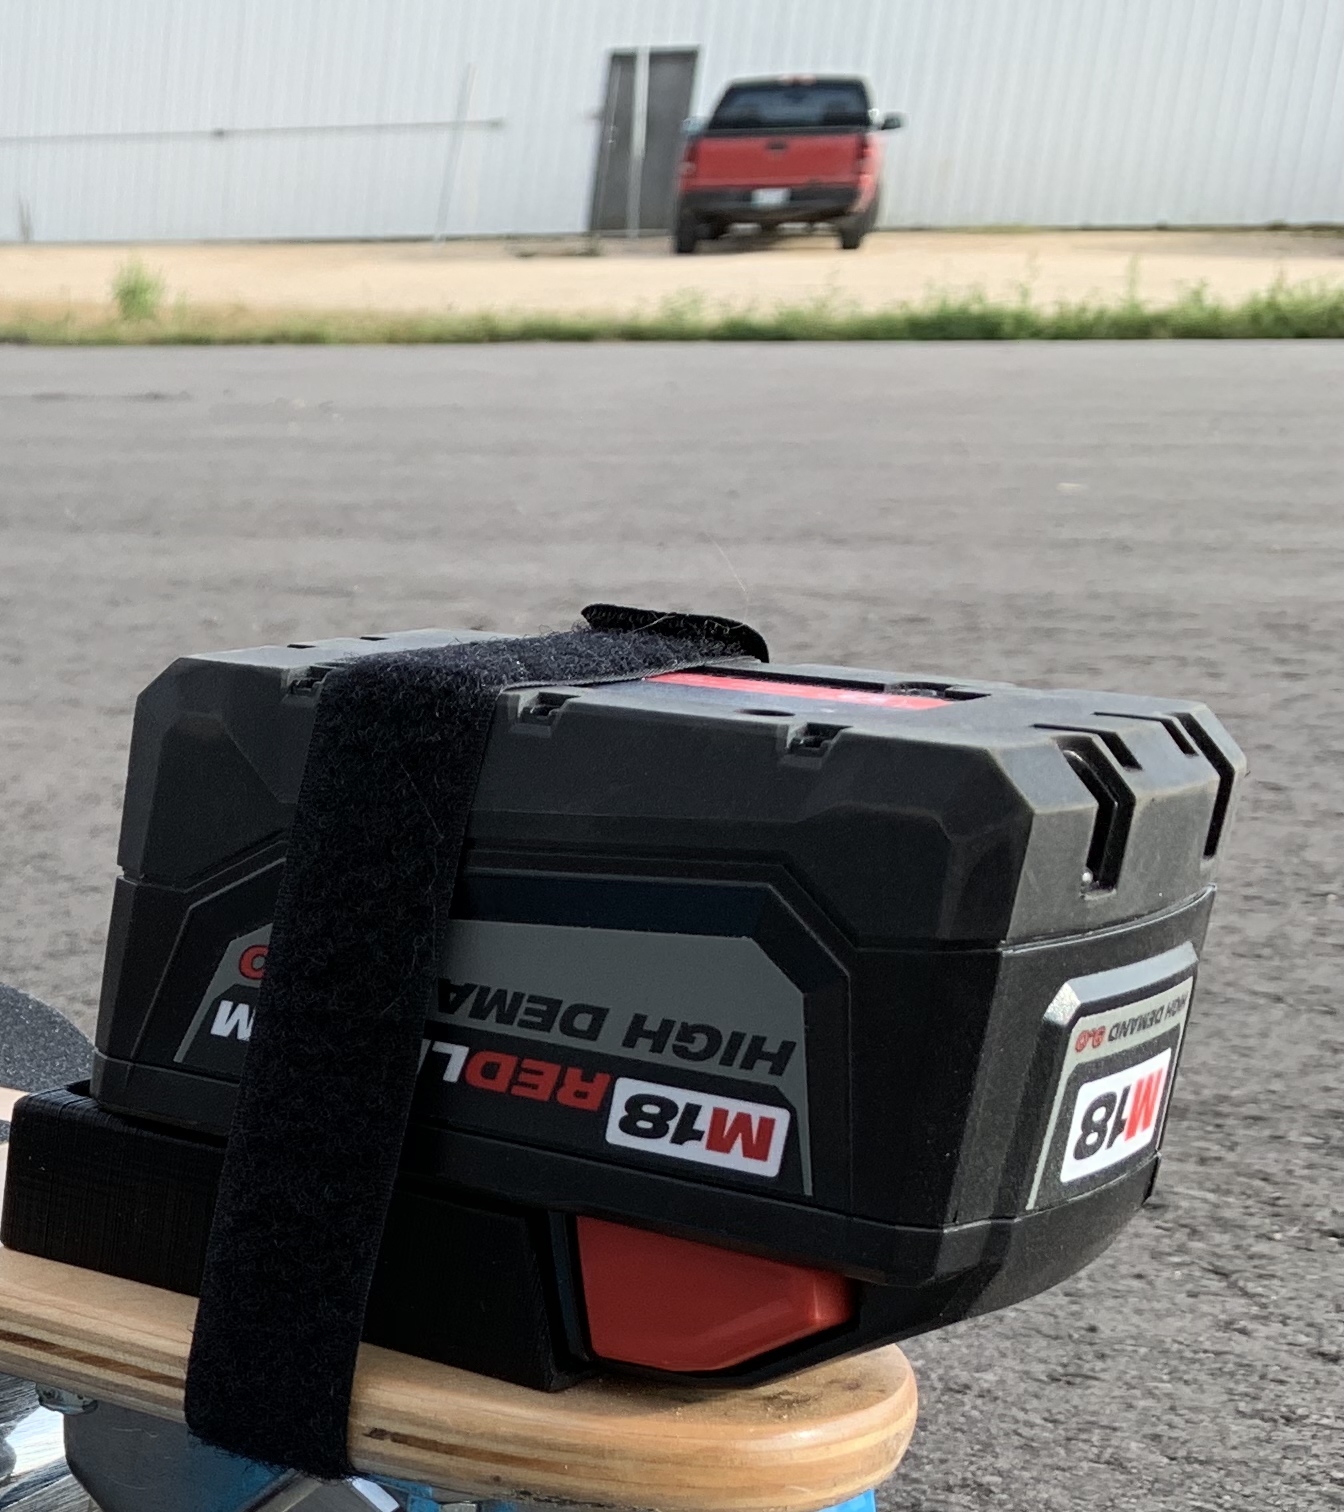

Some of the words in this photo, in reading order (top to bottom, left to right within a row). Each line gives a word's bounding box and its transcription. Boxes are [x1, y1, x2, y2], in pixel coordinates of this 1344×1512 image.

[436, 979, 611, 1042] DEMA
[1107, 1005, 1164, 1042] DEMAND
[621, 1011, 797, 1077] HIGH
[617, 1092, 777, 1162] M18
[1072, 1067, 1164, 1161] M18
